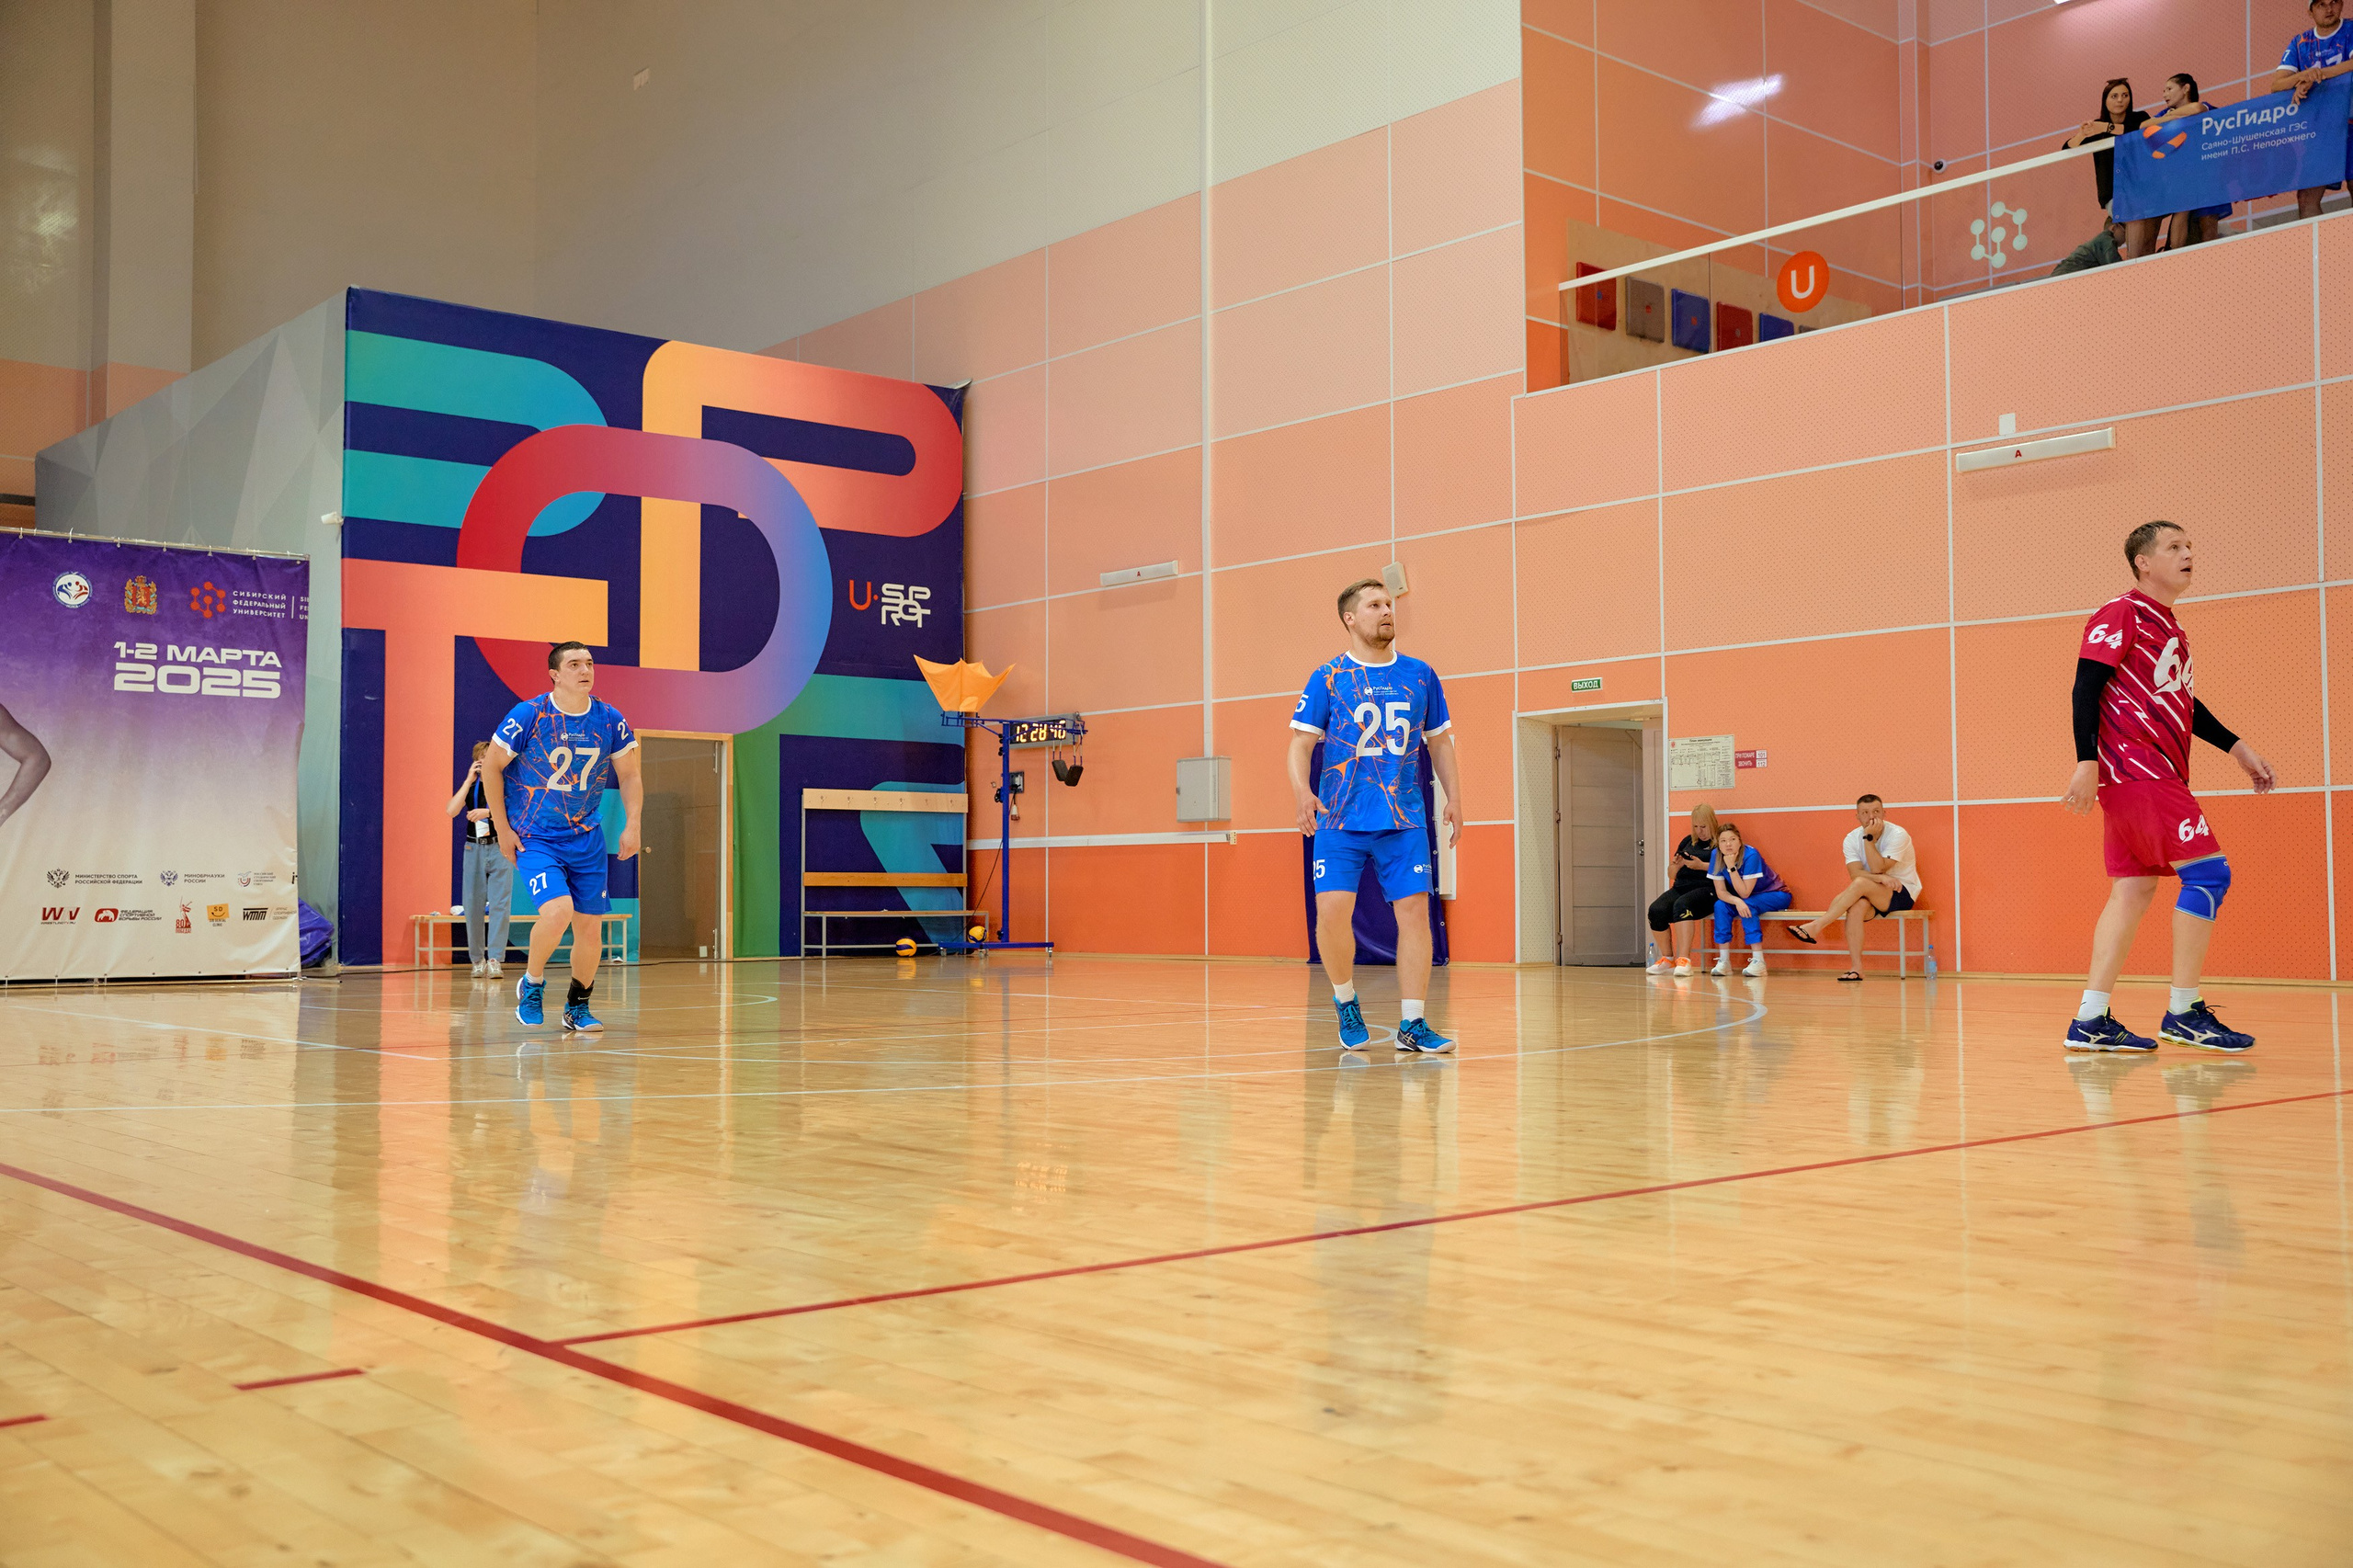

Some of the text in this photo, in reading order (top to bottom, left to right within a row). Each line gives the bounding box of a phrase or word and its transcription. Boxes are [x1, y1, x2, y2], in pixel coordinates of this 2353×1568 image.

[2201, 103, 2299, 136] РусГидро
[2201, 120, 2308, 151] Саяно-Шушенская ГЭС
[2201, 131, 2316, 161] имени П.С. Непорожнего
[233, 590, 287, 600] СИБИРСКИЙ
[233, 599, 286, 609] ФЕДЕРАЛЬНЫЙ
[233, 608, 286, 619] УНИВЕРСИТЕТ
[2087, 623, 2123, 650] 64
[114, 642, 282, 668] 1-2 МАРТА
[114, 662, 281, 699] 2025
[1573, 680, 1599, 690] ВЫХОД
[502, 717, 524, 740] 27
[1353, 701, 1411, 757] 25
[546, 746, 600, 792] 27
[2178, 814, 2209, 844] 64
[529, 872, 549, 895] 27
